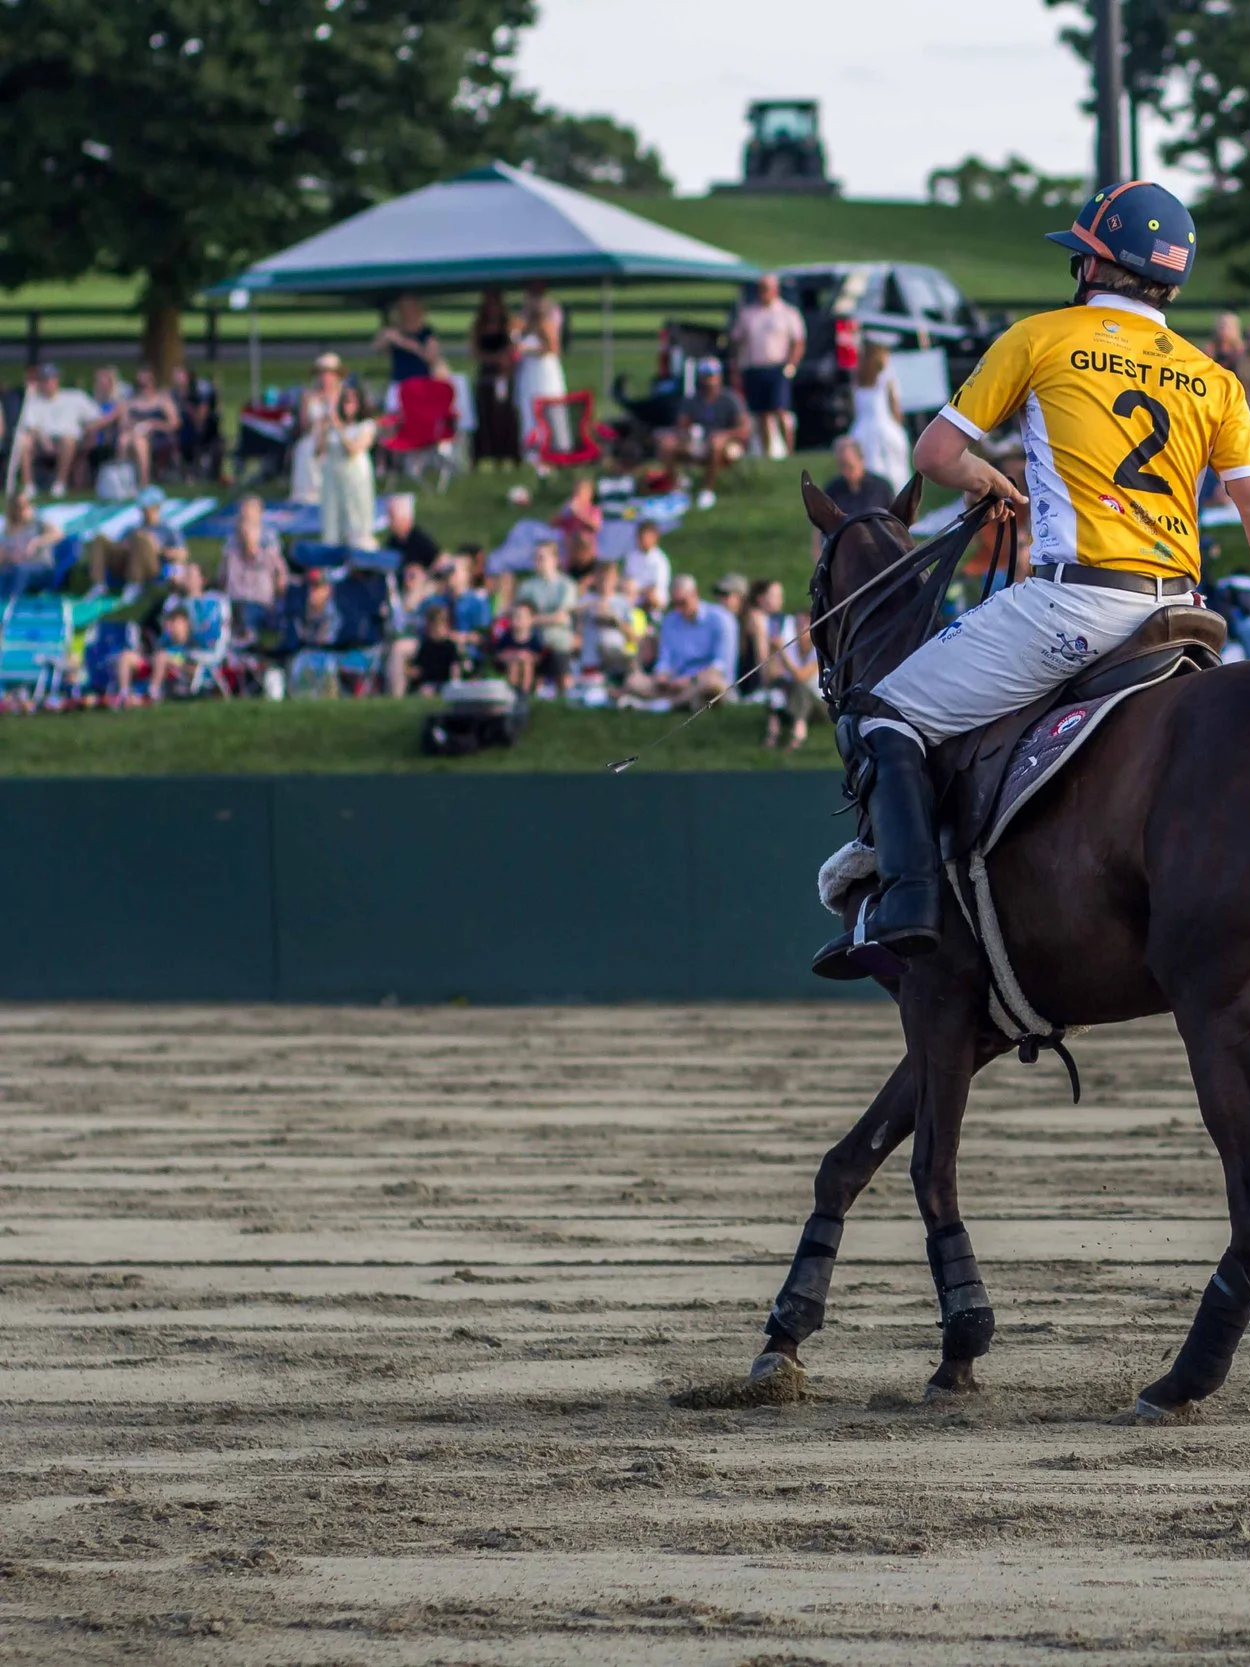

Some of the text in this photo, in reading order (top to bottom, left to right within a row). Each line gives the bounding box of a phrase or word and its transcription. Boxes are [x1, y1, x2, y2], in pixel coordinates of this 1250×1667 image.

[1070, 350, 1153, 385] GUEST
[1159, 367, 1207, 397] PRO
[1112, 389, 1174, 496] 2
